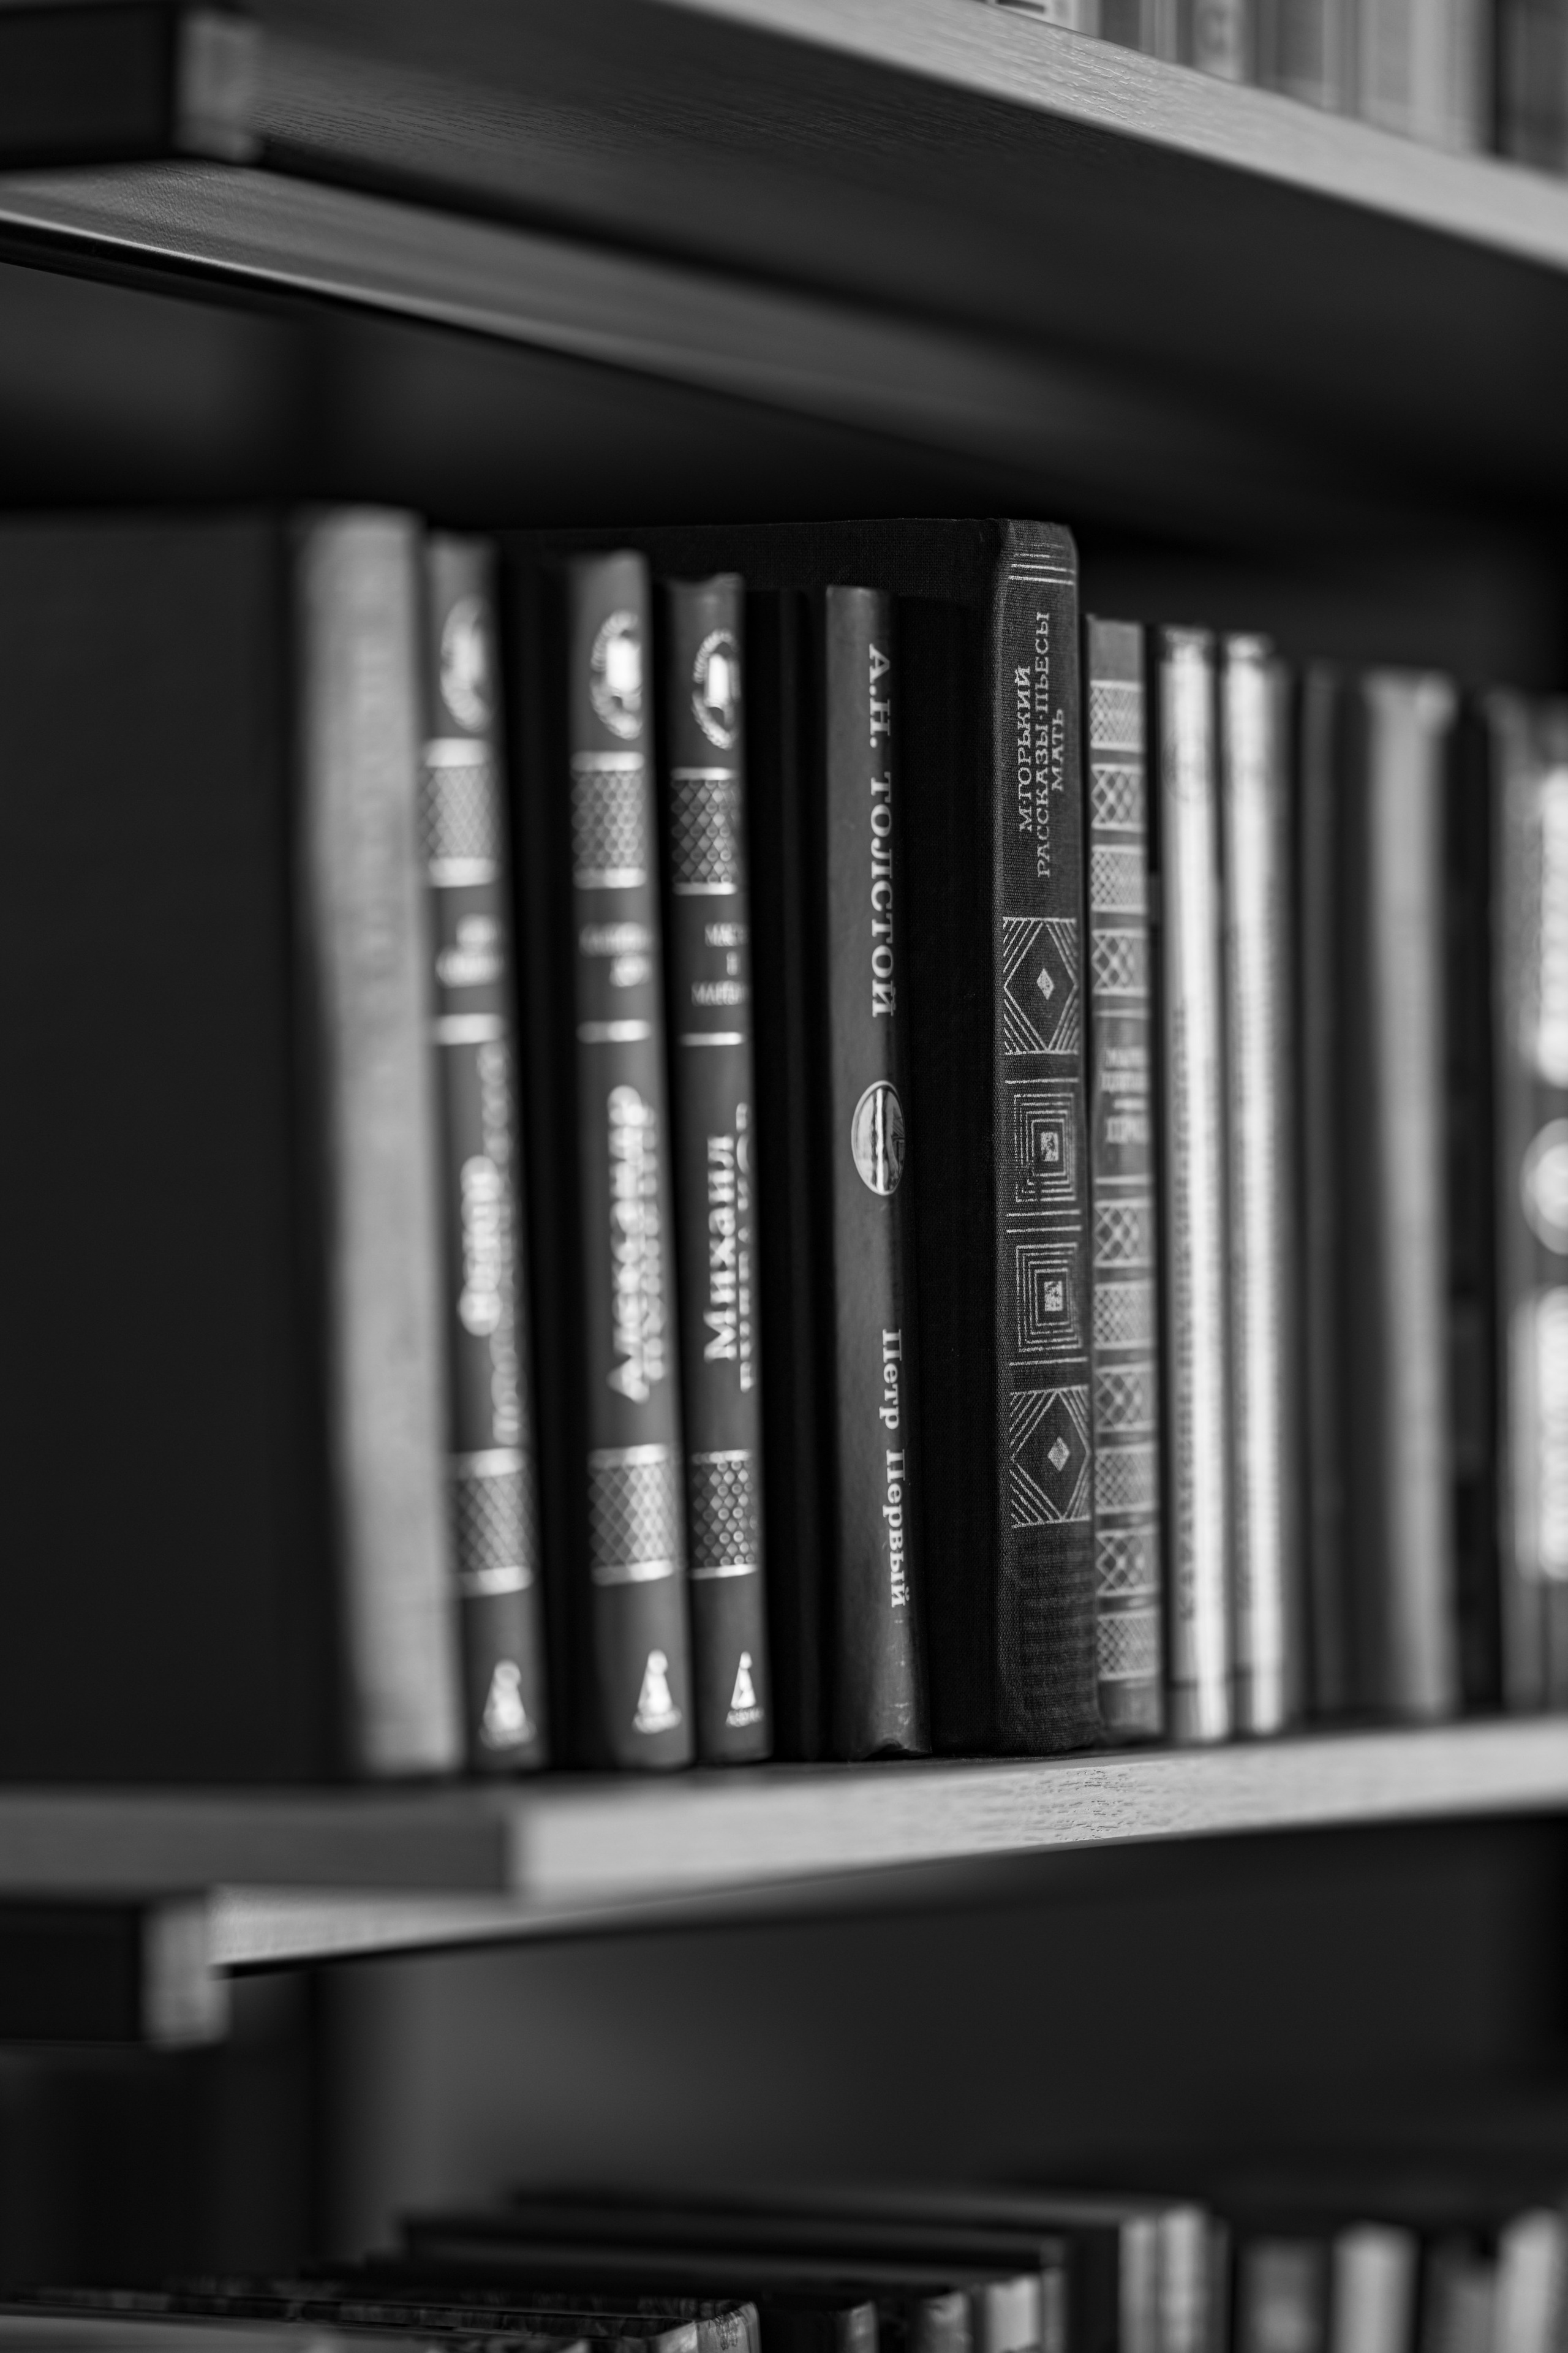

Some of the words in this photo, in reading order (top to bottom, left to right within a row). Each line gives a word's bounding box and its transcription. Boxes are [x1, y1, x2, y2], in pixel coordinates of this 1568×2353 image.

[869, 643, 890, 749] А.Н.
[1052, 708, 1065, 792] МАТЬ
[870, 771, 896, 1018] ТОЛСТОЙ
[703, 1133, 736, 1361] Михаил
[878, 1328, 903, 1430] Петр
[882, 1449, 911, 1608] Первый
